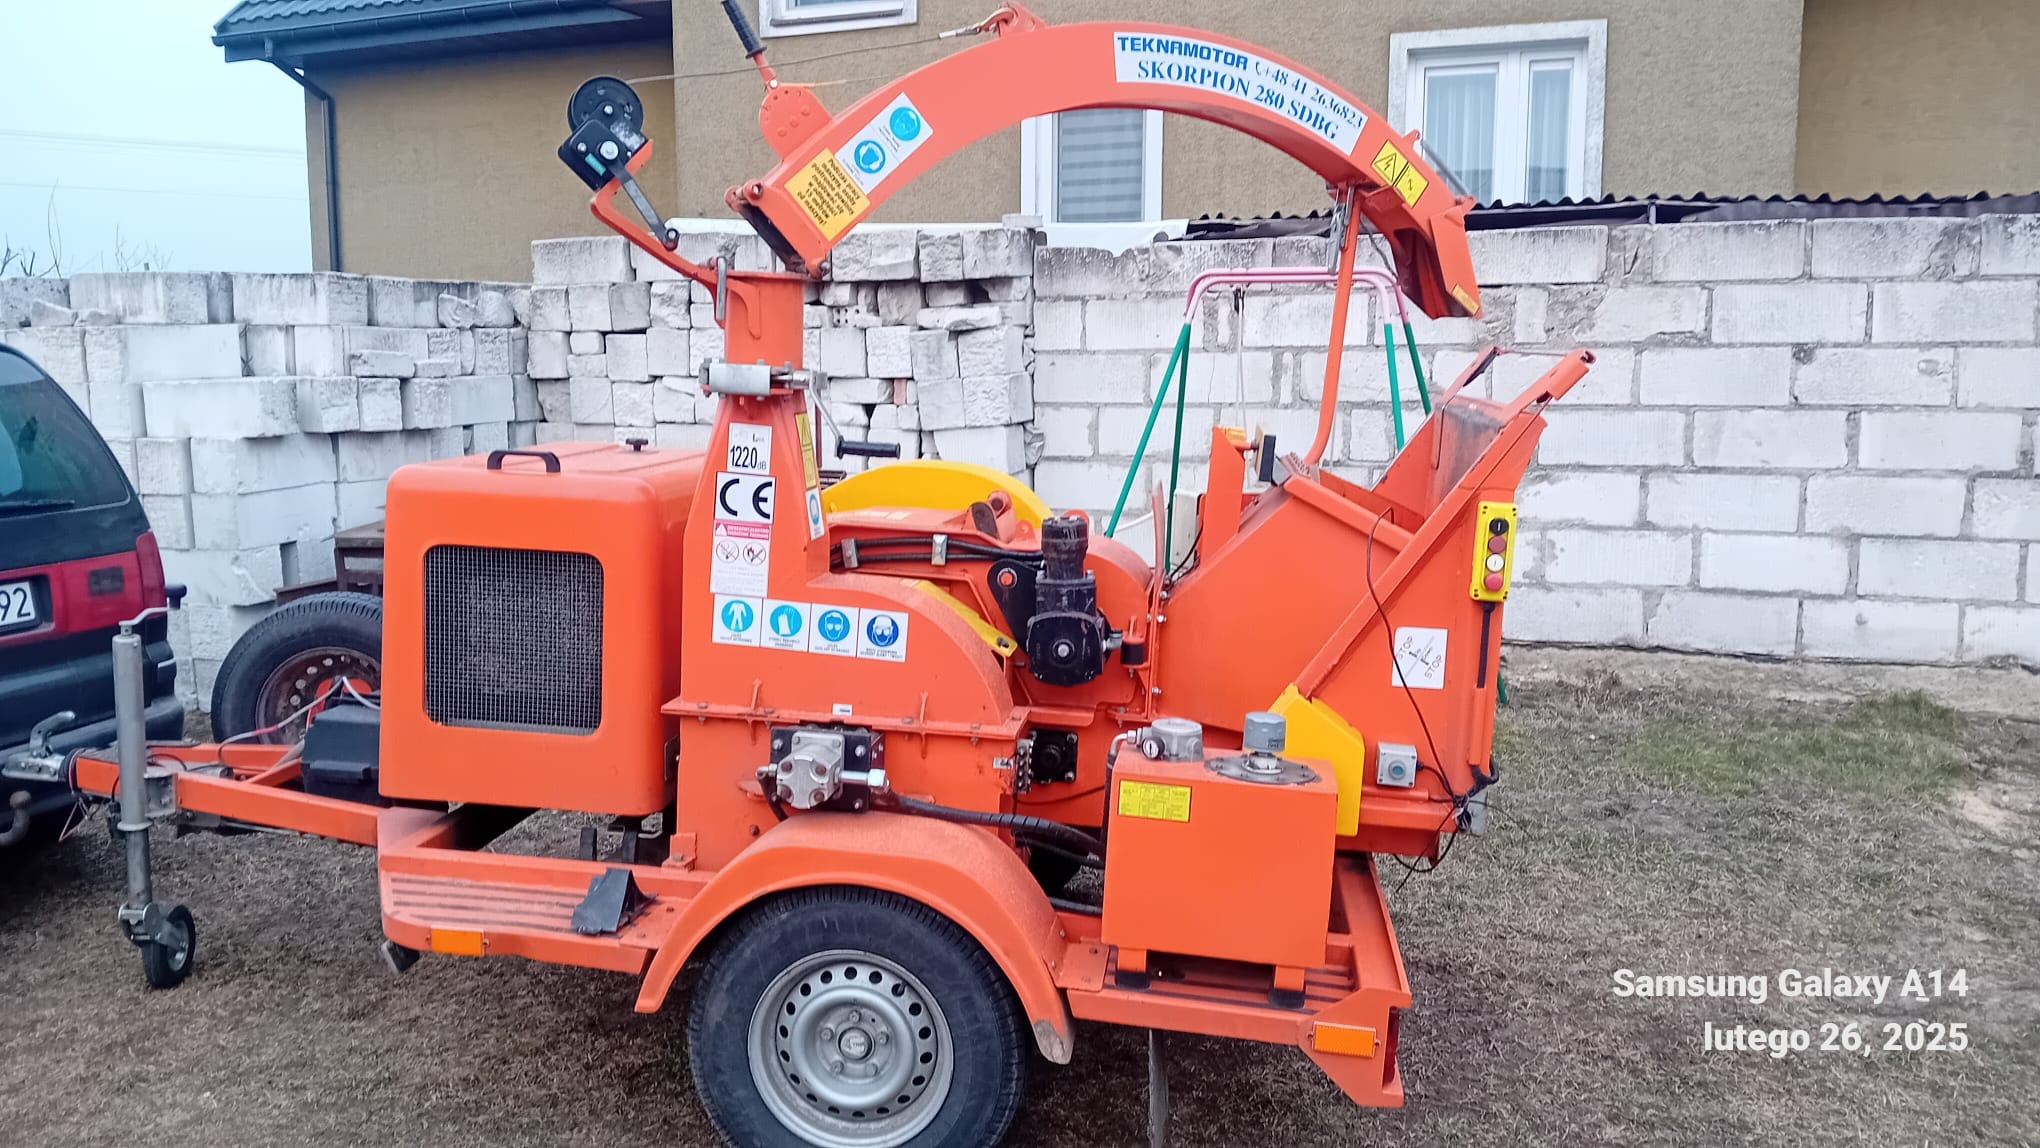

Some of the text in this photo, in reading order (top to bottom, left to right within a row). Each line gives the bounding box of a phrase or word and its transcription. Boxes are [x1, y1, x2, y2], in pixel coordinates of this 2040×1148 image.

[1117, 36, 1249, 71] TEKNAMOTOR
[1138, 60, 1339, 139] SKORPION 280 SDBG
[719, 478, 773, 519] CE
[1394, 635, 1413, 660] STOP
[1423, 654, 1442, 679] STOP
